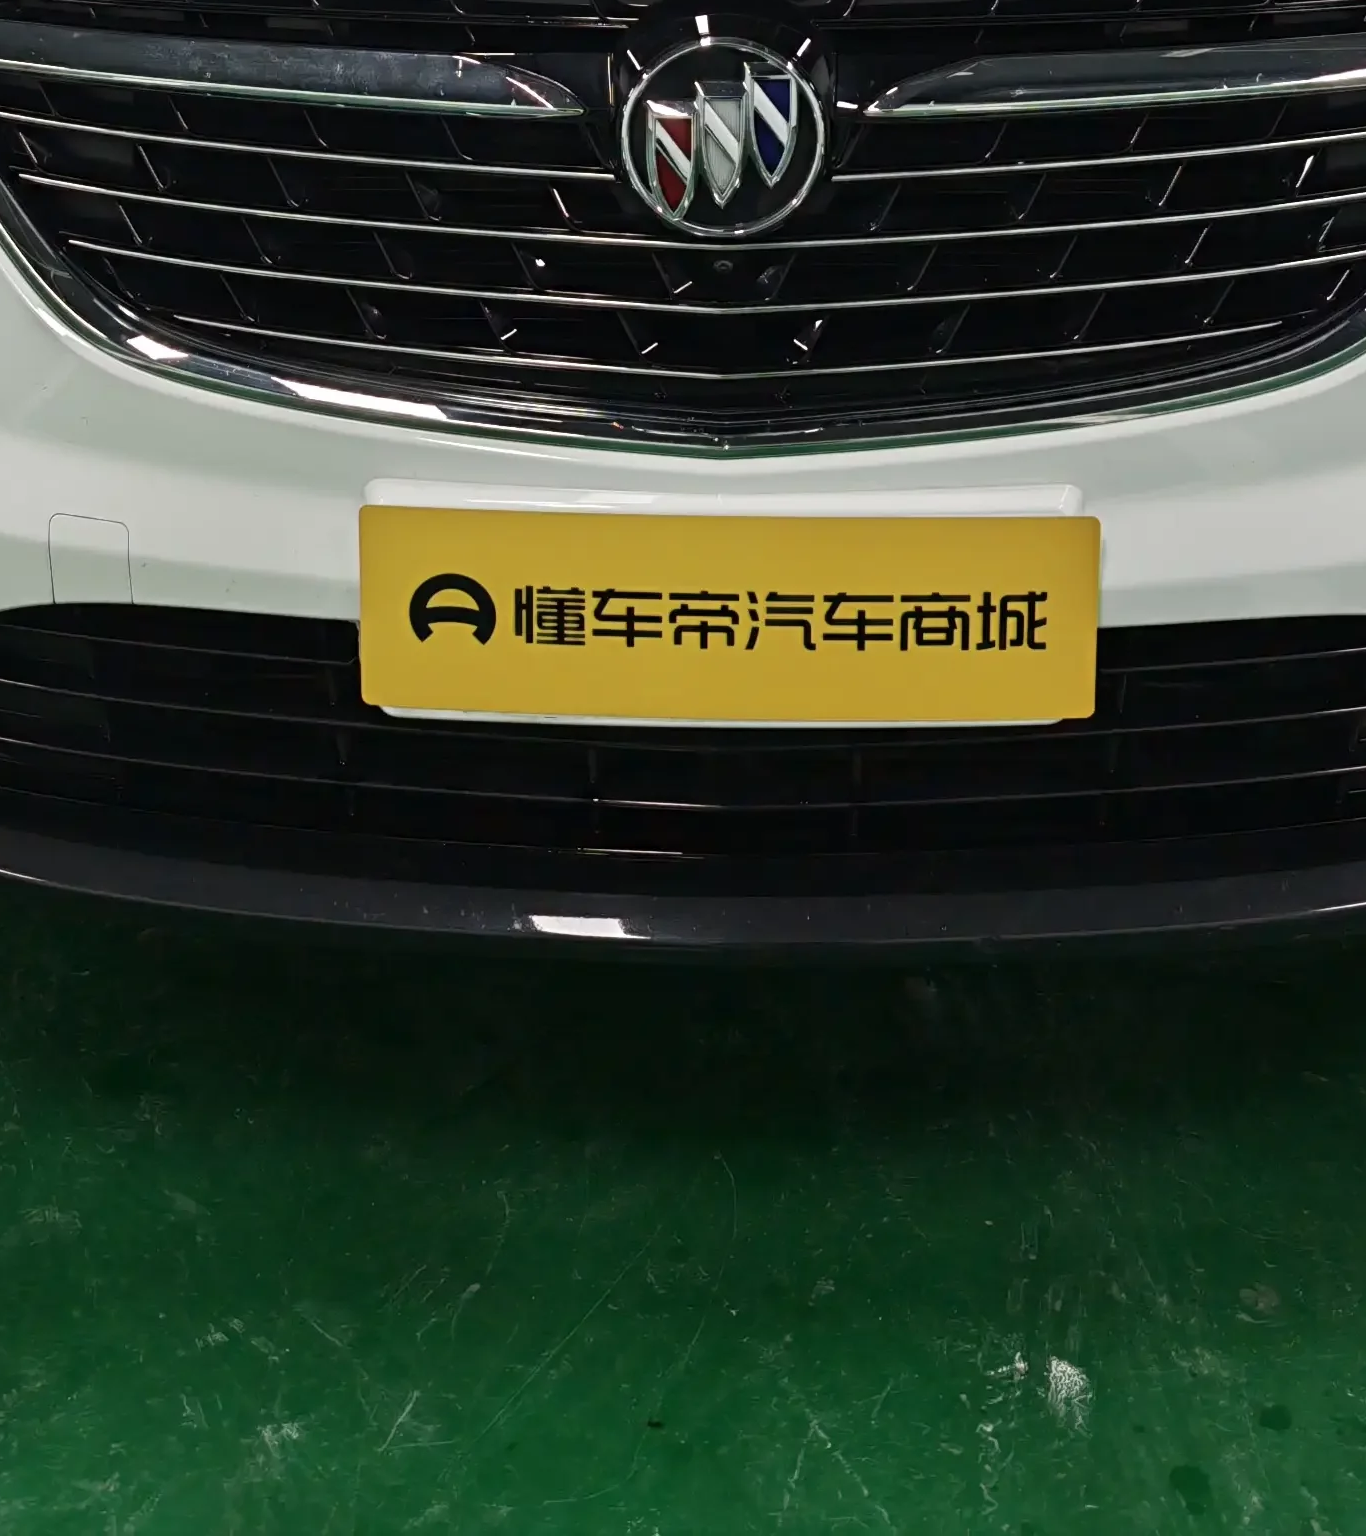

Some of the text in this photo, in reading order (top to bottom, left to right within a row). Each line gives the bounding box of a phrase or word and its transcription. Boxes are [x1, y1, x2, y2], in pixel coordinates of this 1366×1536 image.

[514, 585, 1048, 651] 懂车帝汽车商城
